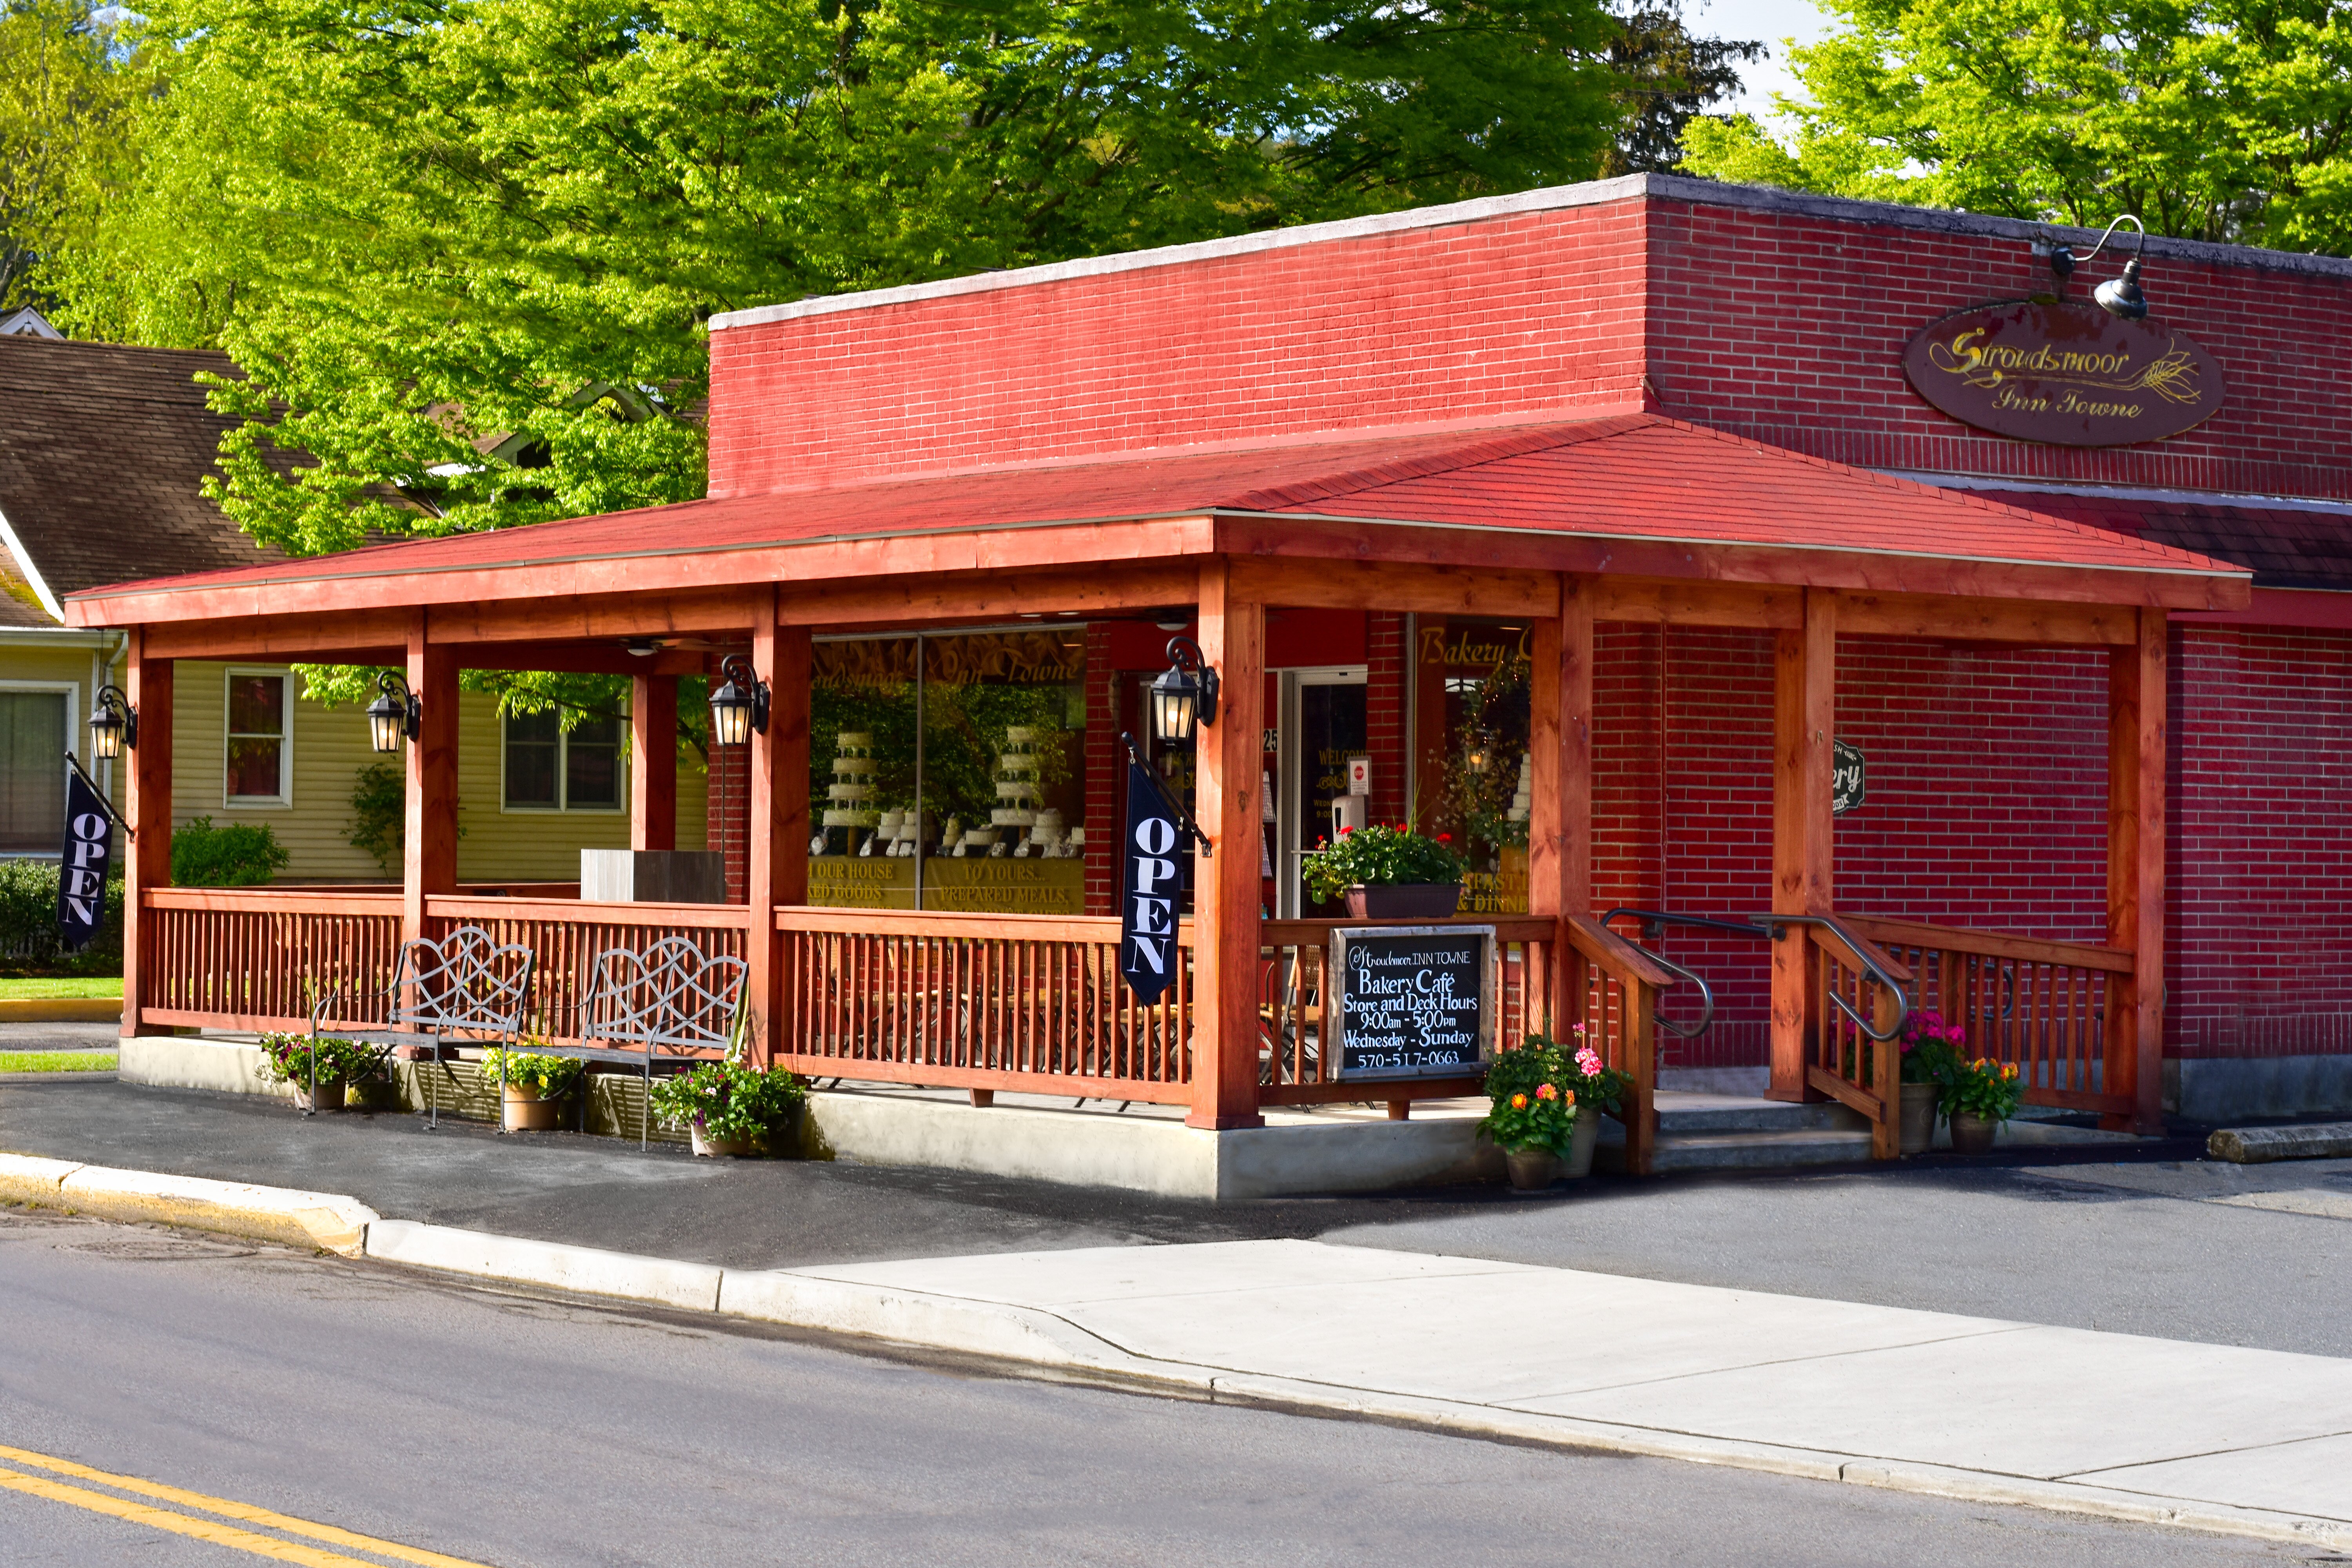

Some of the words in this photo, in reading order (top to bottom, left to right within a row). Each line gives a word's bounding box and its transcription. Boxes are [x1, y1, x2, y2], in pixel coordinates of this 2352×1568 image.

[1929, 327, 2129, 374] Stroudsmoor
[1992, 385, 2053, 412] Inn
[2056, 389, 2144, 418] Towne
[1420, 626, 1506, 666] Bakery
[995, 648, 1078, 682] Towne
[1263, 730, 1277, 751] 25
[62, 813, 106, 926] OPEN
[818, 862, 844, 878] OUR
[849, 863, 893, 879] HOUSE
[964, 864, 982, 880] TO
[987, 864, 1045, 881] YOURS...
[835, 884, 882, 900] GOODS
[941, 886, 1012, 902] PREPARED
[1018, 888, 1069, 905] MEALS,
[1127, 818, 1175, 975] OPEN
[1457, 894, 1468, 911] &
[1413, 953, 1433, 965] INN
[1435, 951, 1470, 964] TOWNE
[1359, 969, 1414, 996] Bakery
[1416, 969, 1455, 993] Café
[1344, 993, 1377, 1013] Store
[1381, 995, 1404, 1011] and
[1408, 993, 1438, 1011] Deck
[1440, 993, 1477, 1010] Hours
[1361, 1011, 1401, 1029] 9:00am
[1413, 1010, 1456, 1028] 5:00pm
[1344, 1030, 1407, 1051] Wednesday
[1419, 1027, 1474, 1048] Sunday
[1359, 1051, 1459, 1068] 570-517-0663
